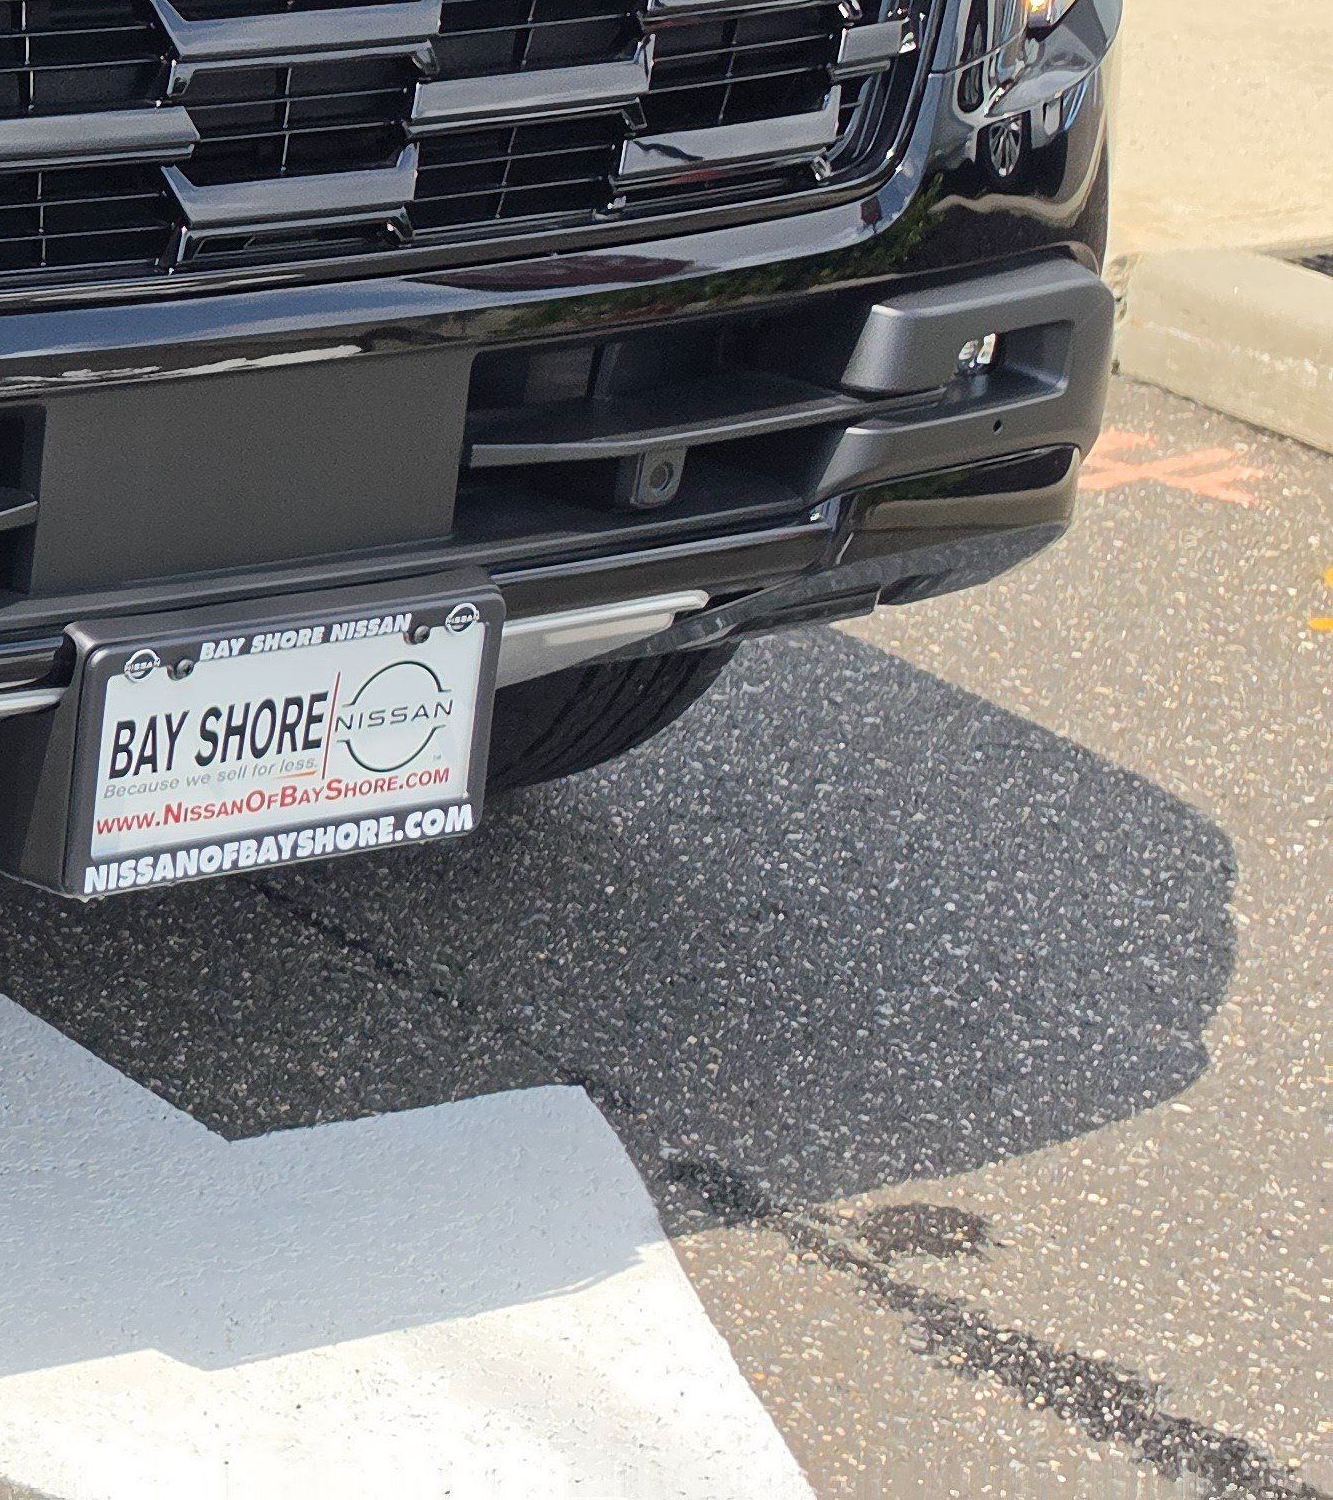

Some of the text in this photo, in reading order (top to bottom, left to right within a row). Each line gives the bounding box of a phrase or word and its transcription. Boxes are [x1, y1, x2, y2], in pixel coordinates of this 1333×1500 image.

[199, 613, 413, 663] BAY SHORE NISSAN
[108, 690, 329, 780] BAY SHORE
[334, 699, 454, 733] NISSAN
[104, 777, 180, 799] Because
[185, 773, 212, 787] we
[216, 765, 248, 783] sell
[251, 762, 276, 778] for
[84, 804, 473, 895] NISSANOFBAYSHORE.COM
